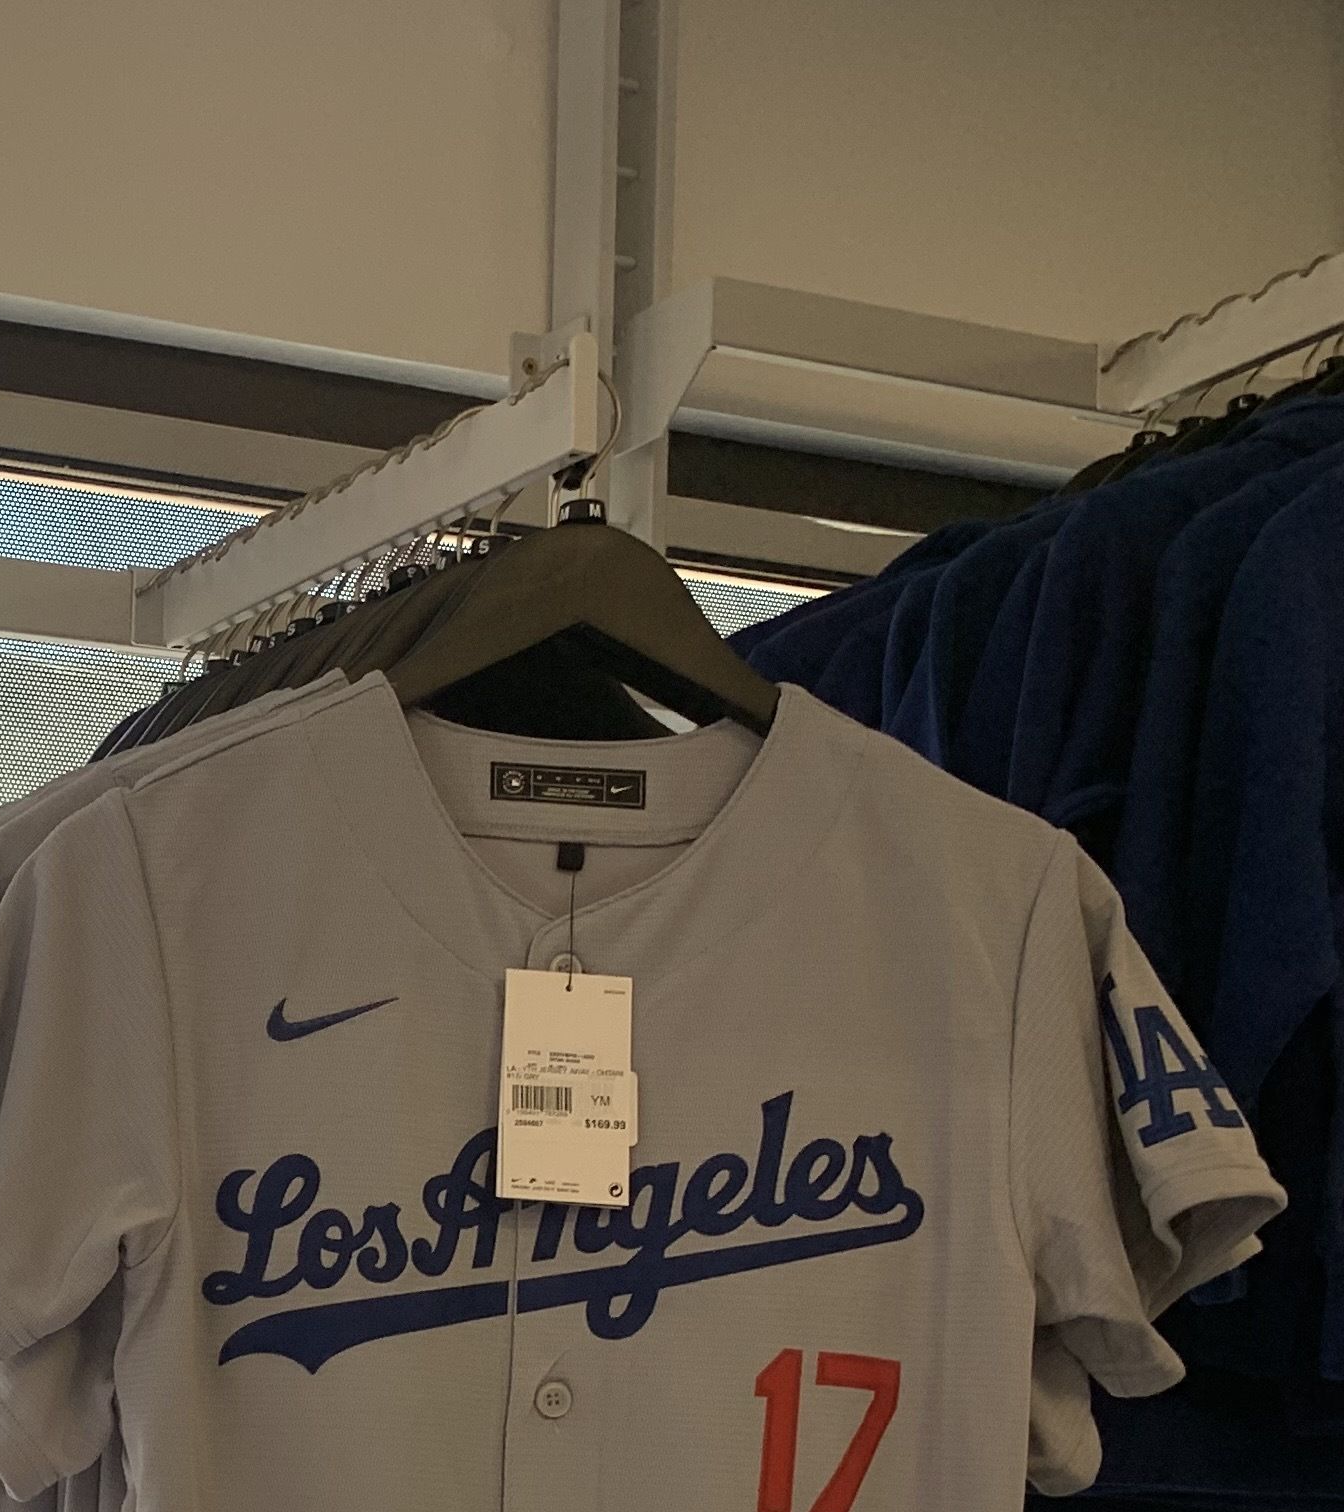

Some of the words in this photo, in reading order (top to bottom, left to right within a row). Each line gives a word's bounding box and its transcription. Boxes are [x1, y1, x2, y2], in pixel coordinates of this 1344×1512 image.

[589, 503, 601, 518] M
[478, 539, 490, 554] S
[1100, 972, 1244, 1148] LA
[590, 1095, 611, 1107] YM
[584, 1118, 627, 1130] $169.99
[202, 1154, 408, 1305] Los
